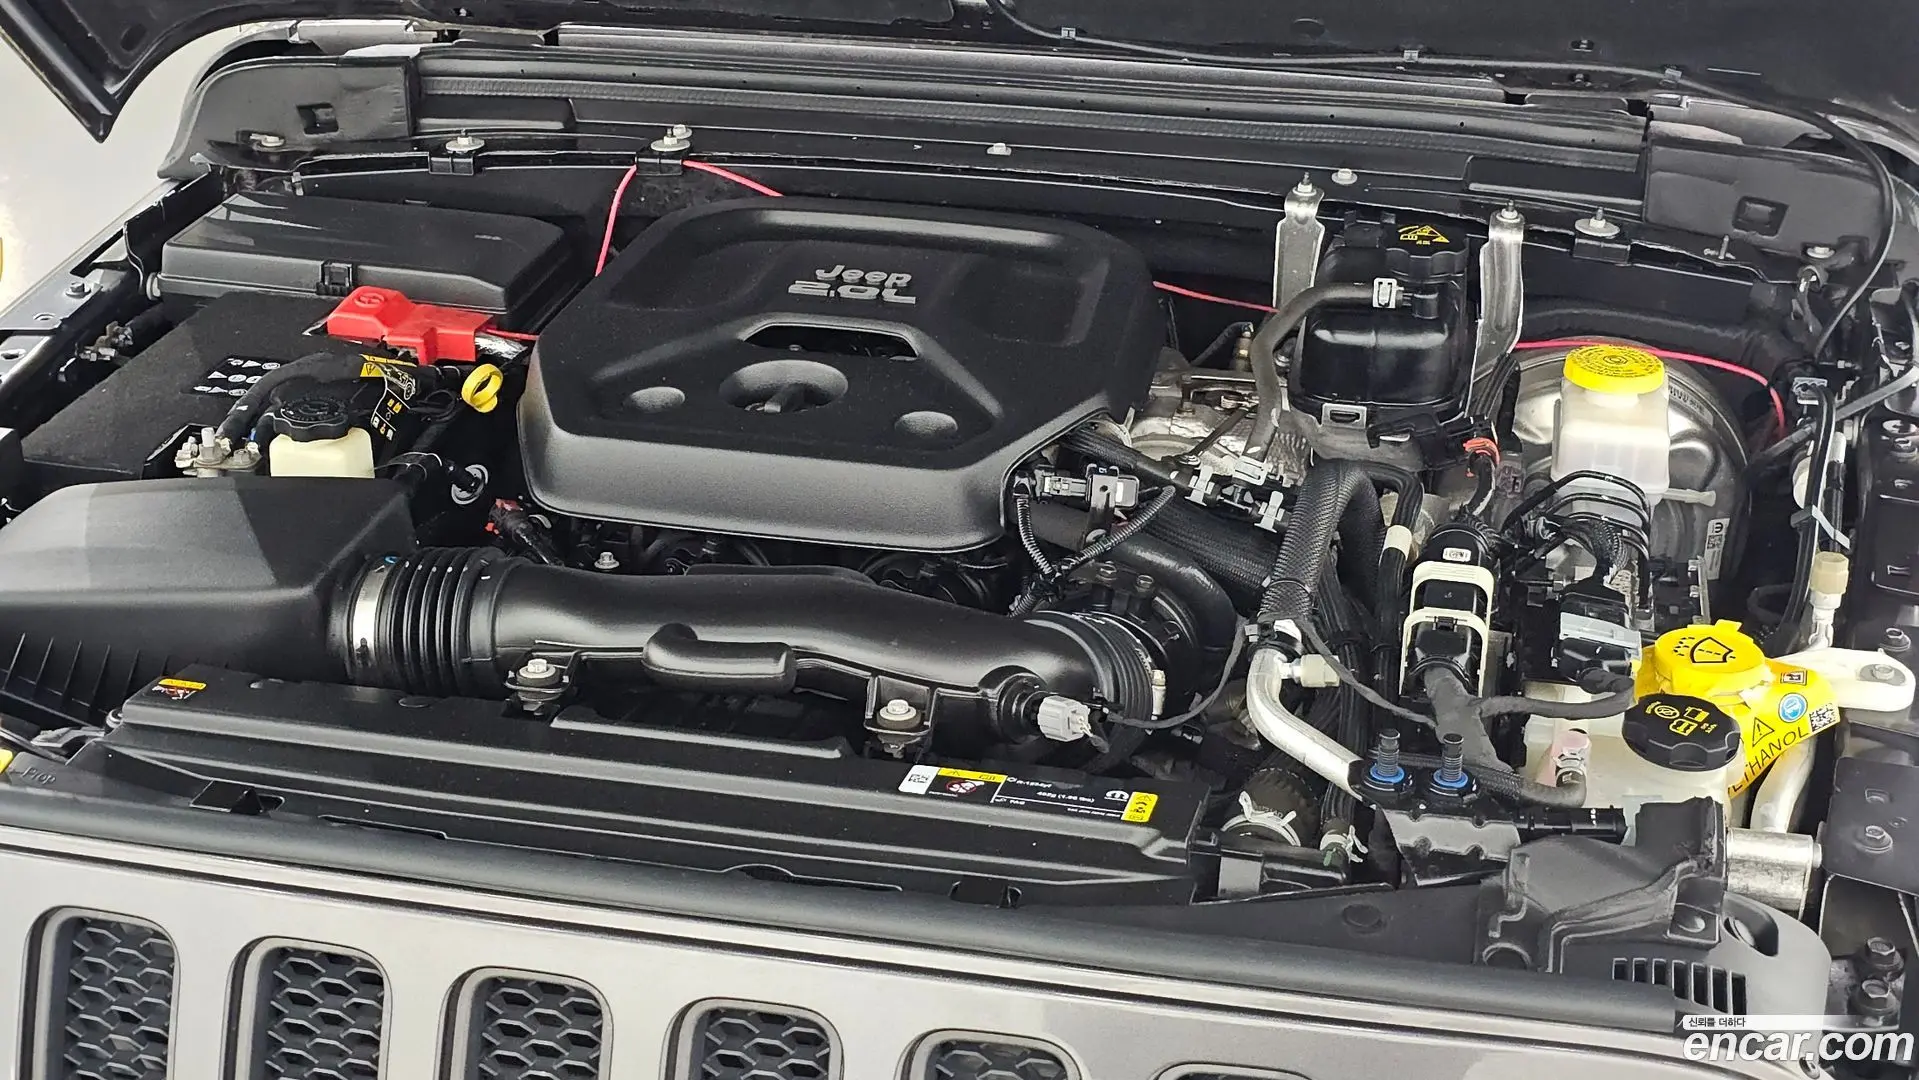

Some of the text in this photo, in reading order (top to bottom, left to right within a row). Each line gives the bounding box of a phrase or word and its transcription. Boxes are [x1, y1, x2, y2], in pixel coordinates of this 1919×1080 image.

[815, 264, 912, 289] Jeep
[788, 280, 916, 304] 2.0L
[1727, 726, 1809, 795] THANOL
